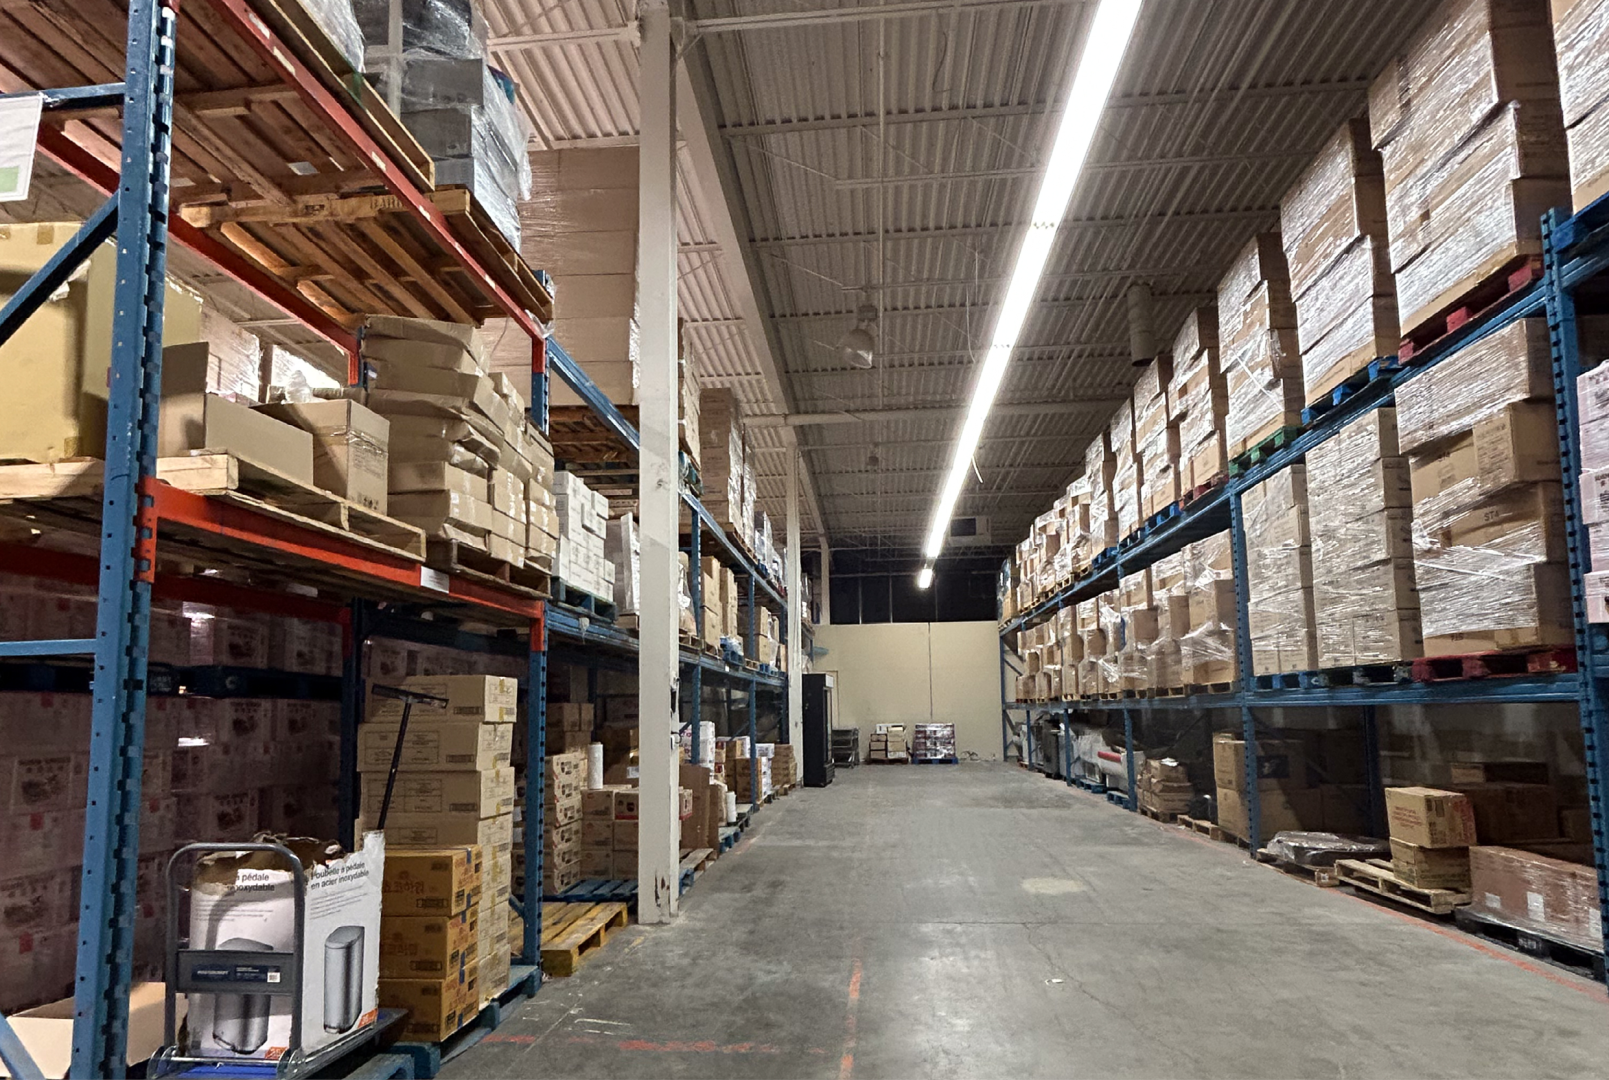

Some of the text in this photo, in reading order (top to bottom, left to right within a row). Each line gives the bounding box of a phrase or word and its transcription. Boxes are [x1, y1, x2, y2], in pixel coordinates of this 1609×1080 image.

[242, 872, 270, 883] pédale
[310, 881, 321, 890] en
[321, 878, 338, 888] acier
